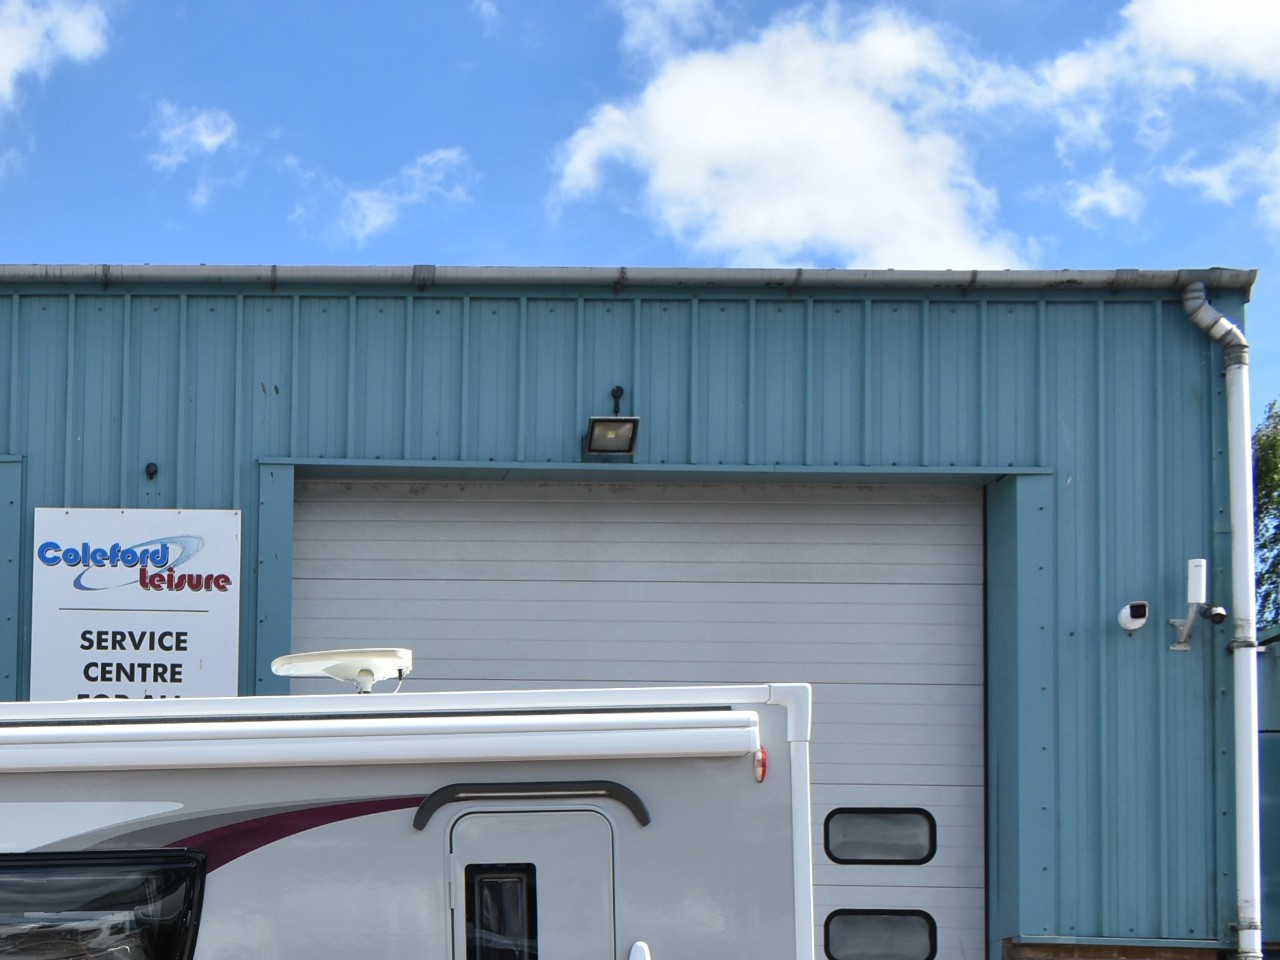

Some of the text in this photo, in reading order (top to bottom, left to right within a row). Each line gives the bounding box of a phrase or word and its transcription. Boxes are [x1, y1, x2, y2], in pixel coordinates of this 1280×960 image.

[37, 541, 170, 567] Coleford
[80, 630, 188, 651] SERVICE
[83, 662, 183, 683] CENTRE
